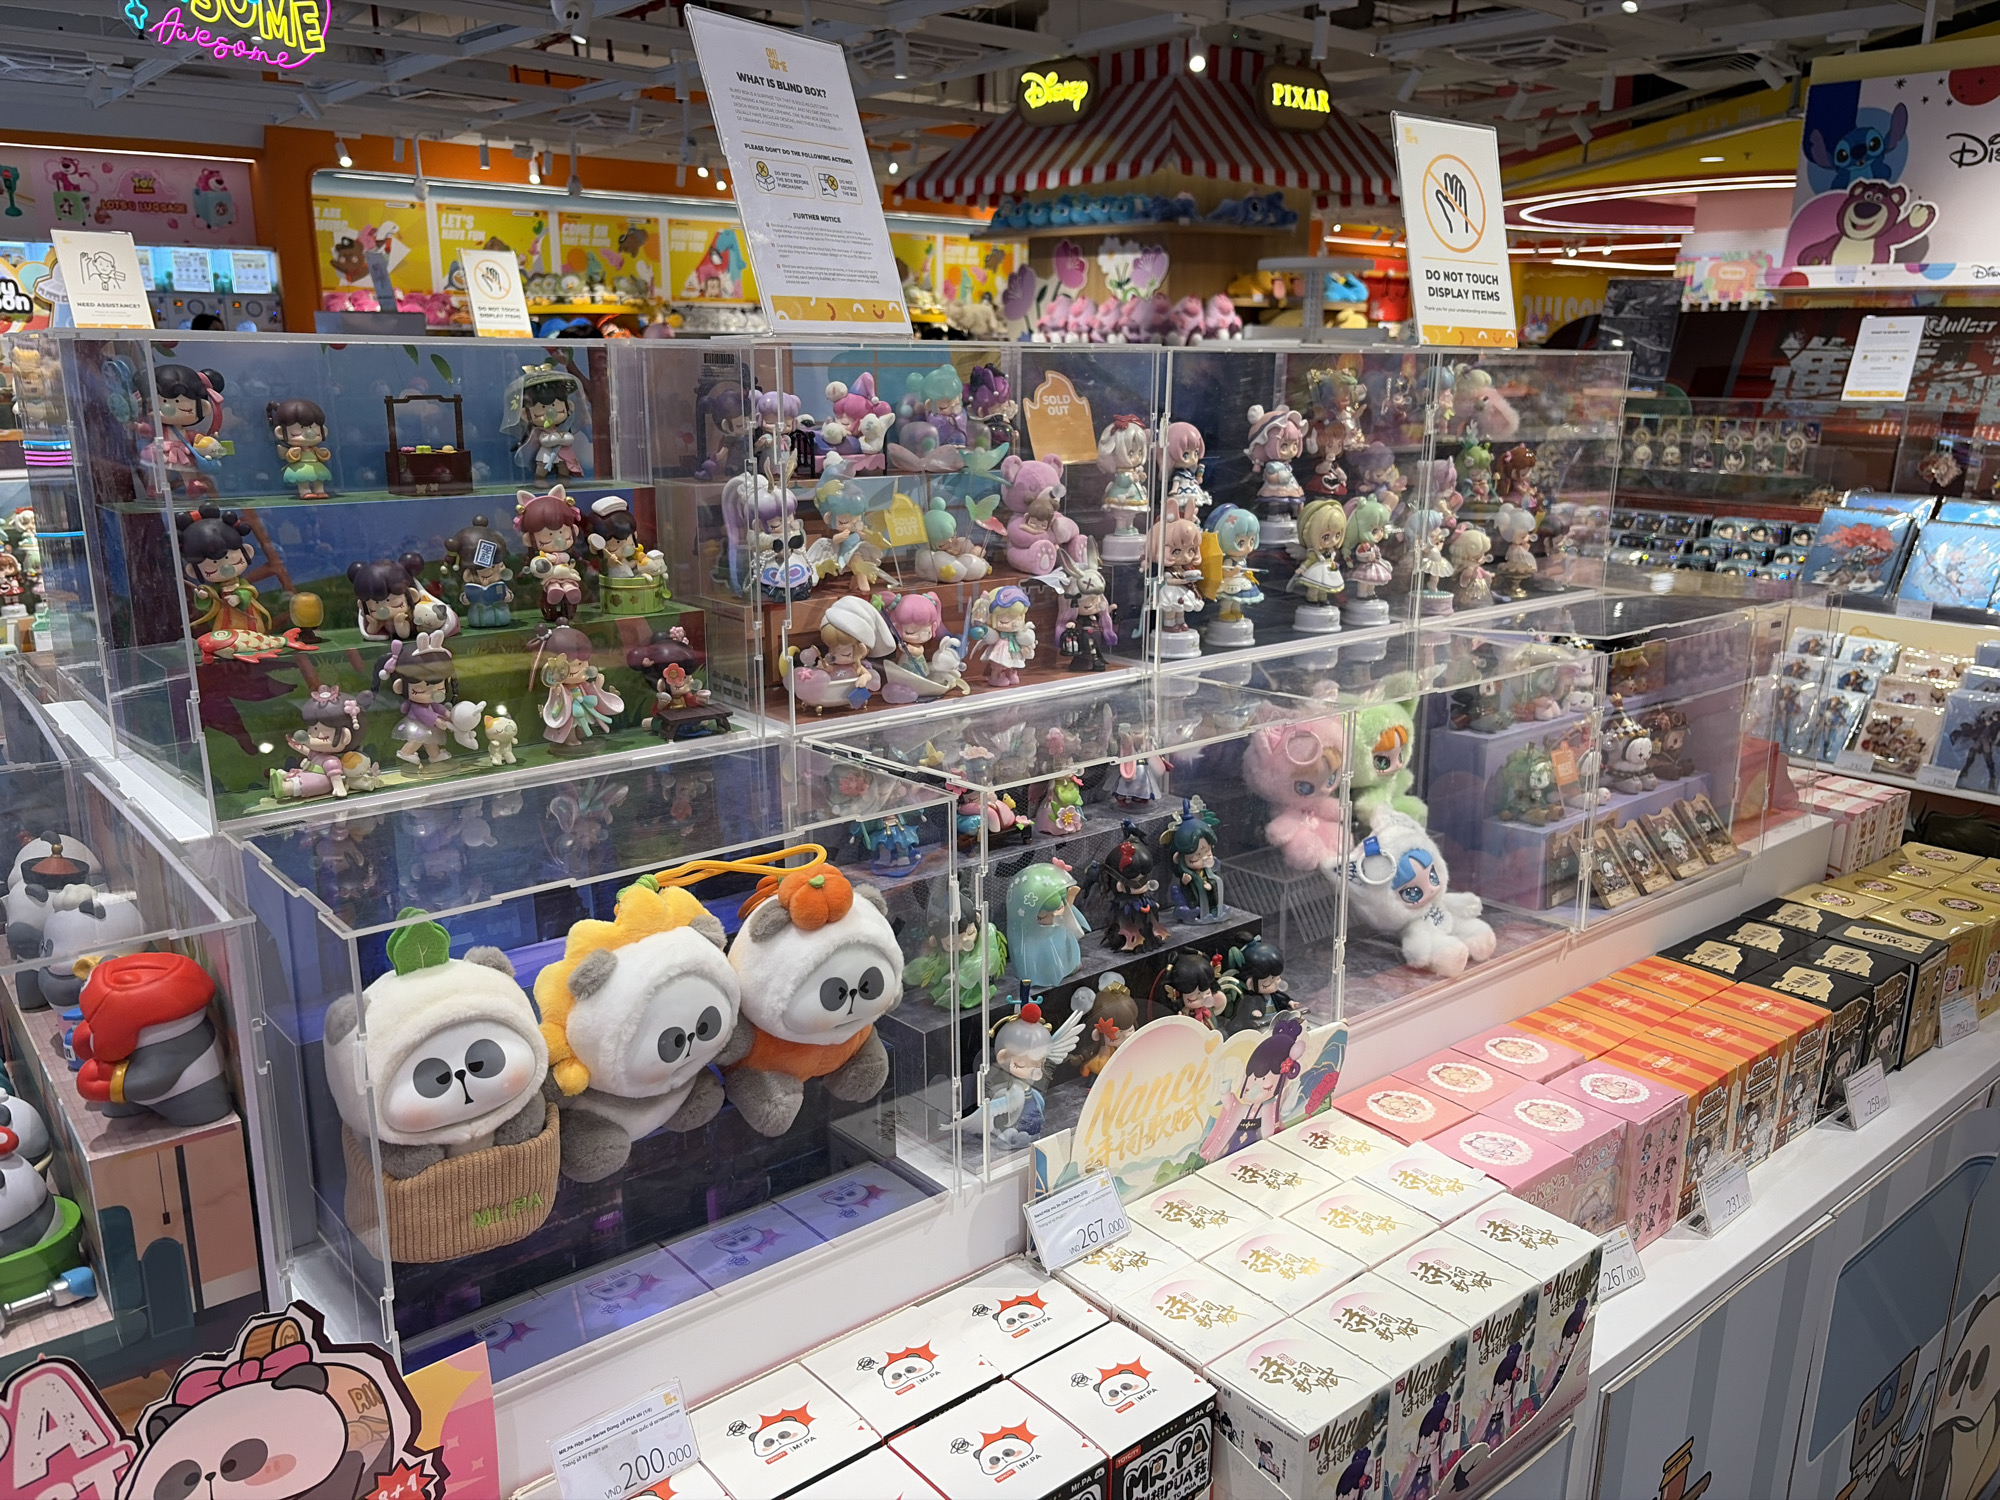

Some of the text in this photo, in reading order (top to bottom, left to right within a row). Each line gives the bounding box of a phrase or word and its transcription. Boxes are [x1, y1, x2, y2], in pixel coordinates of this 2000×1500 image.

[149, 7, 315, 69] Awesome
[736, 71, 827, 98] WHAT IS BLIND BOX?
[1021, 71, 1089, 111] Disney
[1271, 82, 1331, 113] PIXAR
[744, 143, 765, 152] PLEASE
[765, 146, 781, 154] DON'T
[801, 152, 831, 161] FOLLOWING
[777, 183, 803, 191] PURCHASING
[440, 213, 475, 229] LET'S
[792, 212, 820, 221] FURTHER
[467, 230, 486, 242] FUN
[1425, 269, 1499, 286] DO NOT TOUCH
[1428, 286, 1500, 302] DISPLAY ITEMS
[1042, 395, 1071, 405] SOLD
[1047, 406, 1069, 416] OUT
[892, 516, 917, 527] SOLD
[894, 526, 919, 537] OUT
[1077, 1218, 1125, 1249] 267.000
[1603, 1265, 1640, 1291] 267.000
[1033, 1315, 1053, 1329] Mr.PA
[919, 1370, 941, 1384] Mr.PA
[1138, 1387, 1159, 1402] Mr.PA
[626, 1414, 636, 1424] PUA
[1185, 1409, 1204, 1424] Mr.PA
[792, 1436, 817, 1451] Mr.PA
[1019, 1454, 1042, 1470] Mr.PA
[1117, 1448, 1140, 1466] TOYCITY
[604, 1443, 692, 1500] VND 200.000
[1071, 1475, 1093, 1493] Mr.PA
